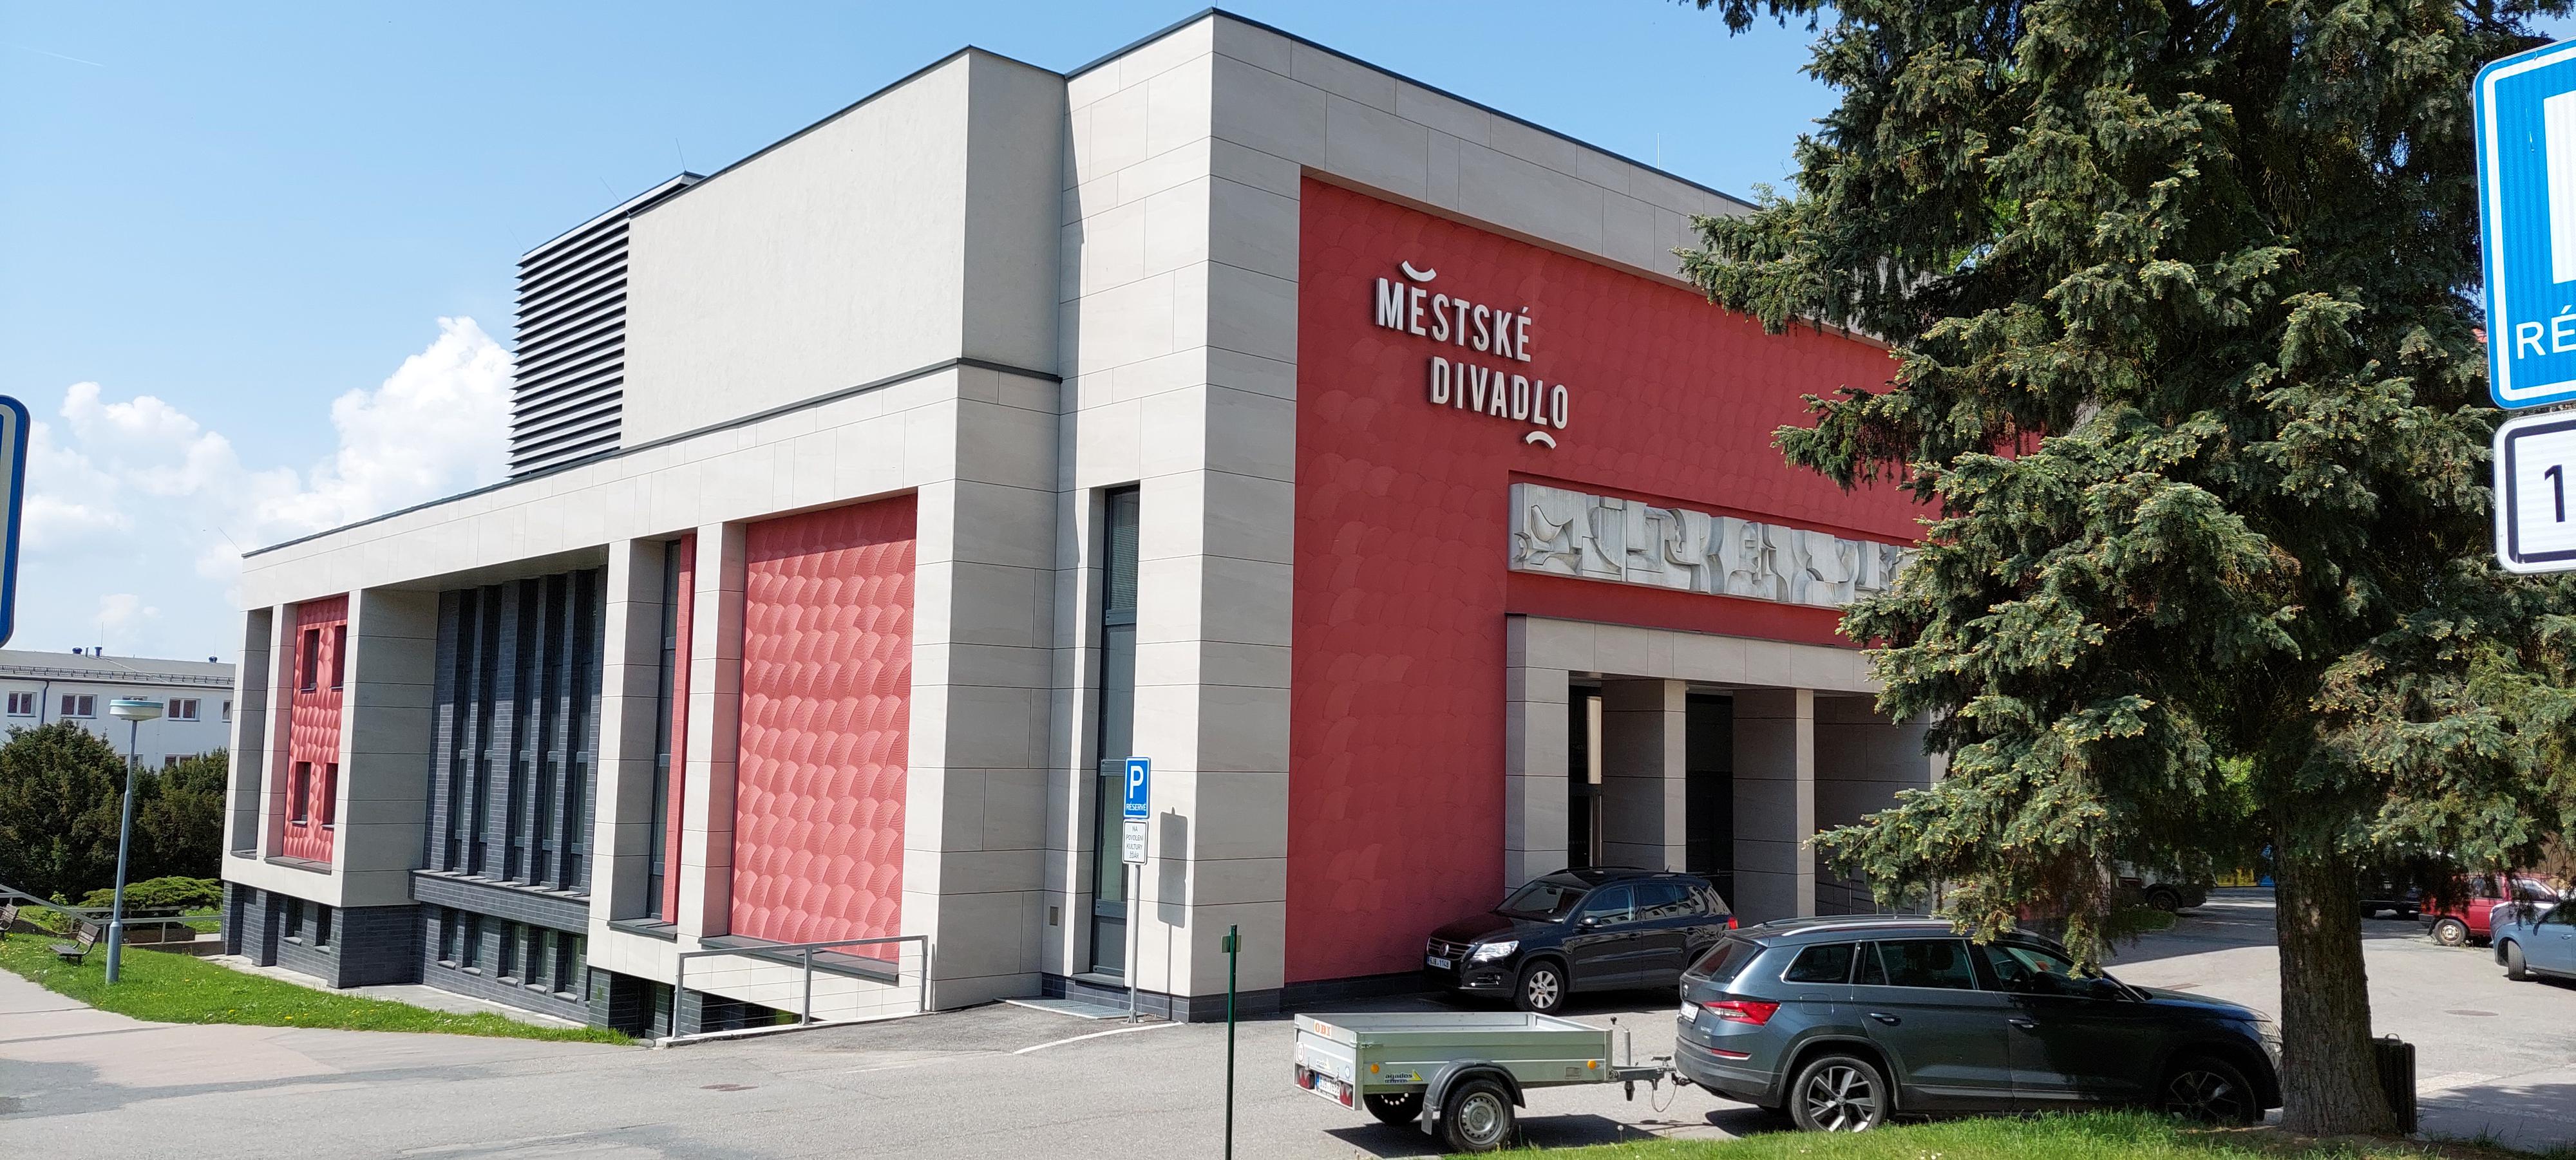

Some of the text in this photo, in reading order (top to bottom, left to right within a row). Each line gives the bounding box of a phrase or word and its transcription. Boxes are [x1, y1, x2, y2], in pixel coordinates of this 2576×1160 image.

[1430, 355, 1569, 429] DIVADLO
[1129, 765, 1144, 799] P
[1126, 801, 1146, 811] RÉSERVÉ
[1315, 1022, 1331, 1037] OBI
